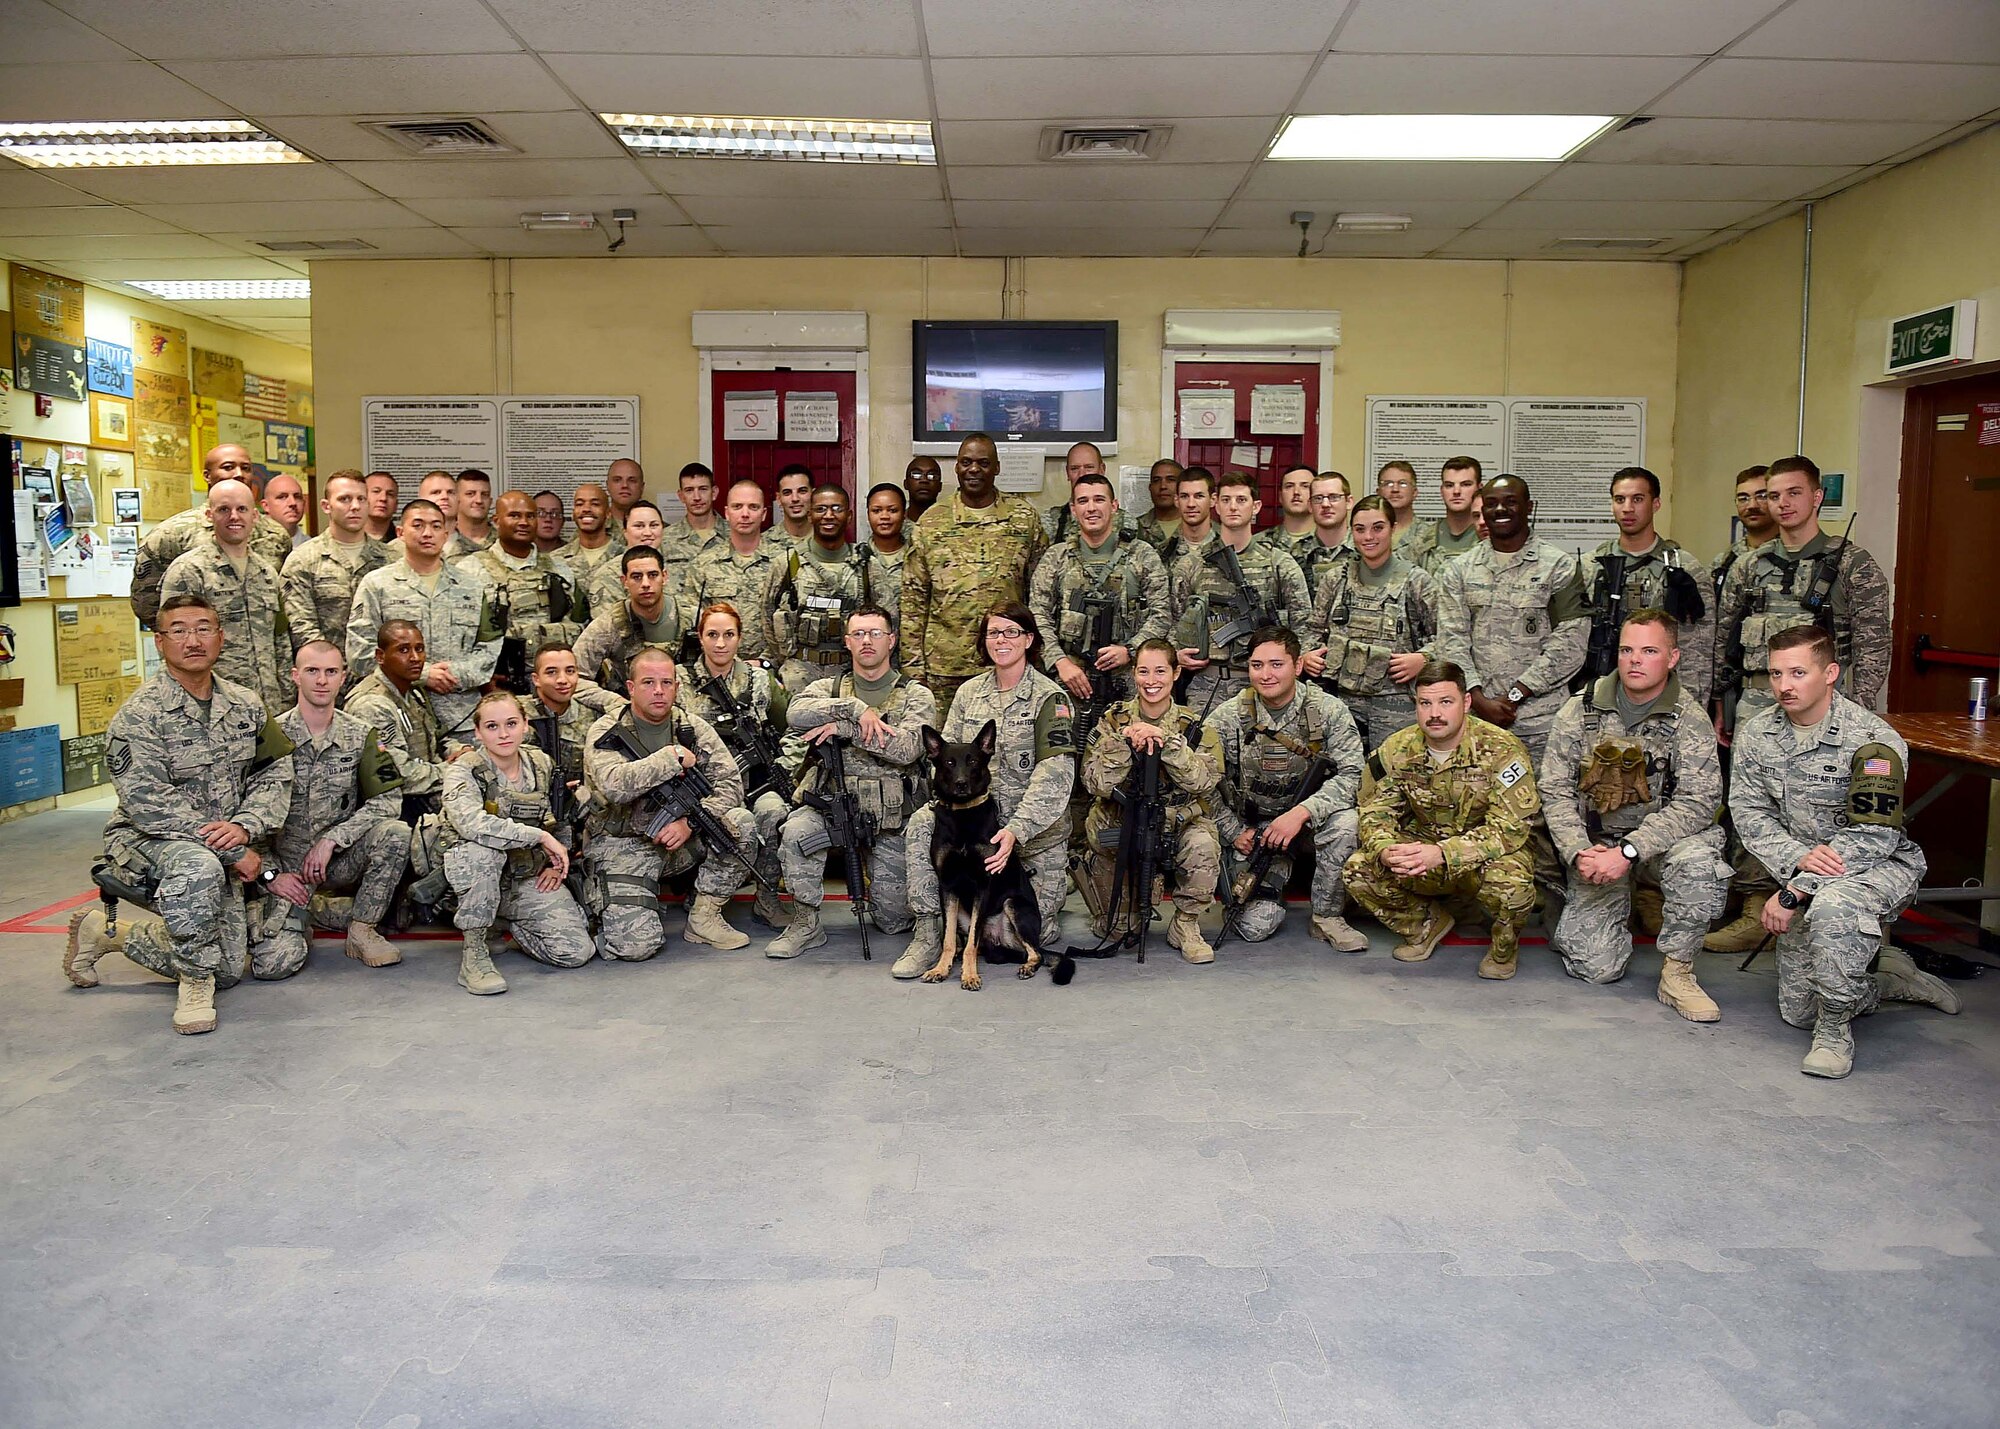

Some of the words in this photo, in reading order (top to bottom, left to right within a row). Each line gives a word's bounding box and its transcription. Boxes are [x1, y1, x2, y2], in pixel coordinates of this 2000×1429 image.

[1891, 327, 1919, 360] EXIT
[1920, 320, 1950, 354] مخرج
[84, 667, 99, 679] SET
[1048, 730, 1073, 748] S
[1502, 763, 1520, 784] SF
[1832, 777, 1852, 785] FORC
[1852, 792, 1900, 816] SF
